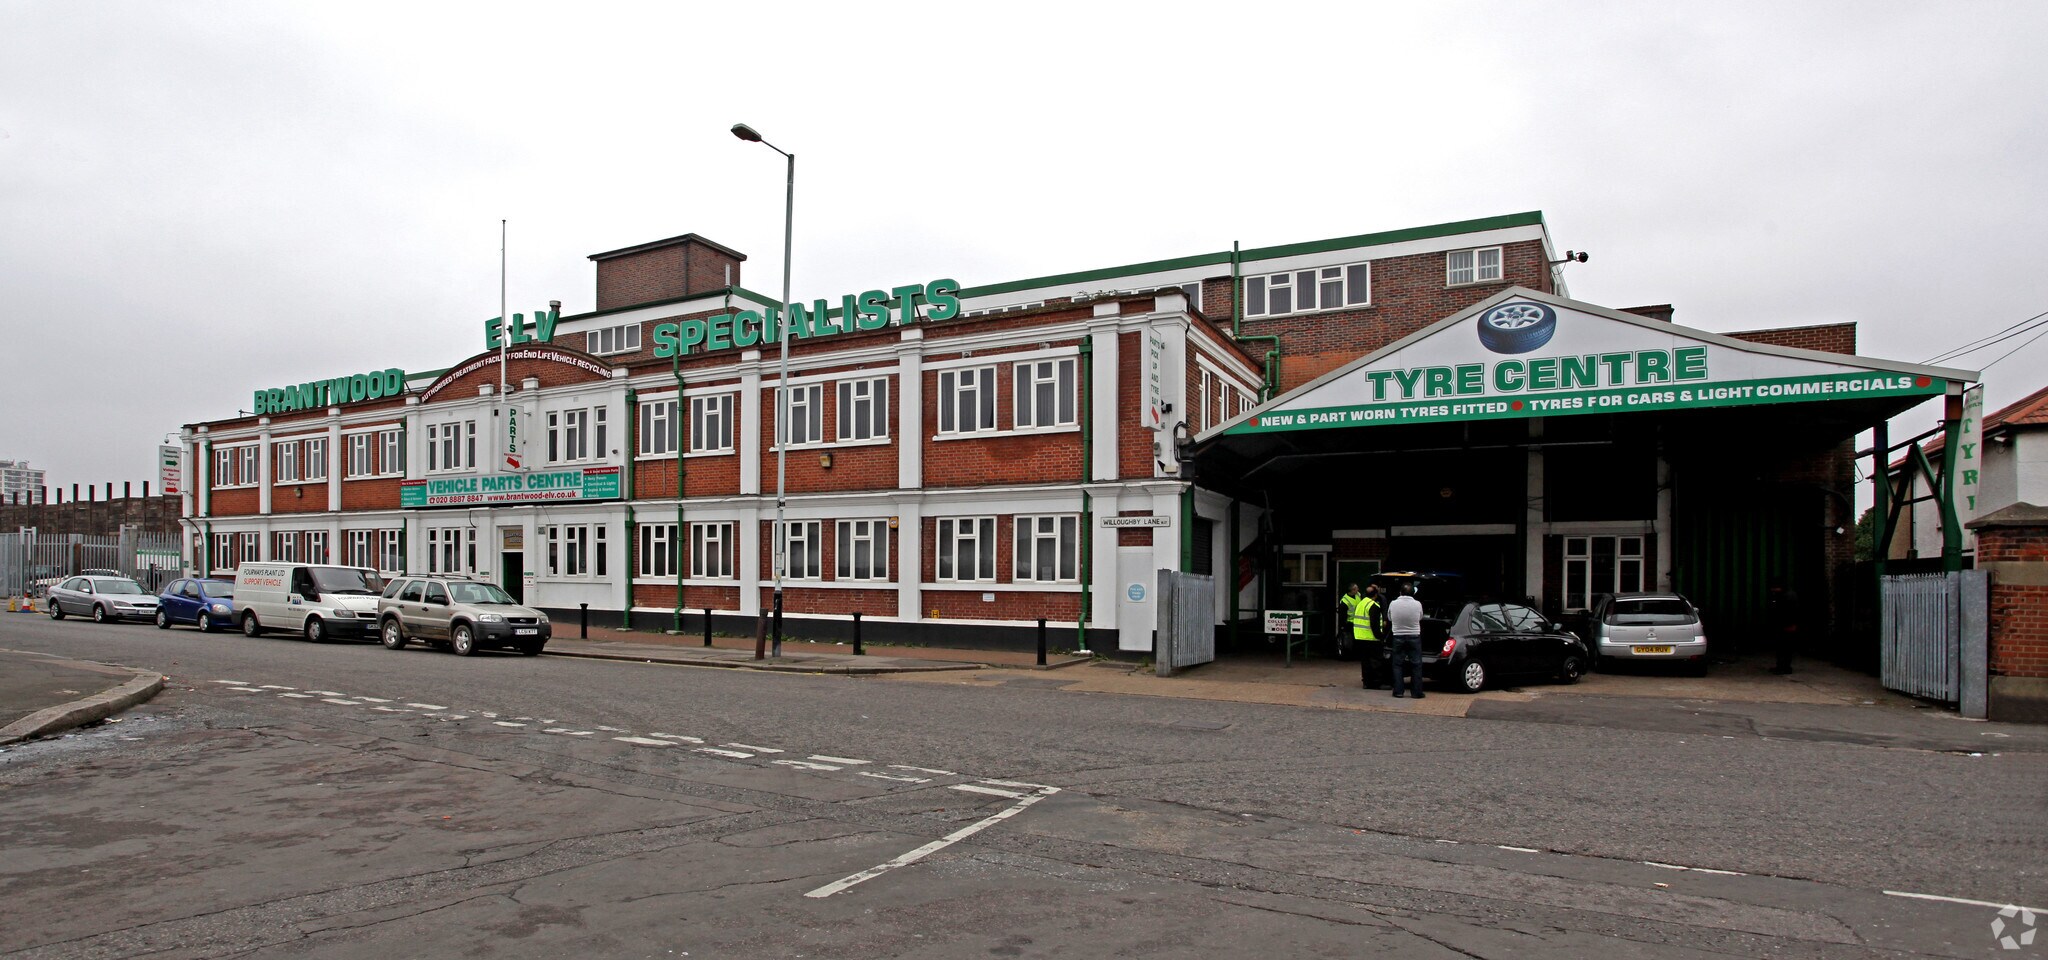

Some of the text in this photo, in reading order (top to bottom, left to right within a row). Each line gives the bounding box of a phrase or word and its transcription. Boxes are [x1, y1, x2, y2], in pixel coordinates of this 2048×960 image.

[485, 311, 559, 350] ELV
[653, 278, 960, 358] SPECIALISTS
[254, 368, 404, 415] BRANTWOOD
[421, 375, 453, 403] AUTHORISED
[452, 360, 485, 379] TREATMENT
[485, 352, 512, 365] FACILY
[577, 360, 612, 378] RECYCLING
[1365, 346, 1708, 401] TYRE CENTRE
[1529, 376, 1912, 411] TYRES FOR CARS & LIGHT COMMERCIALS
[1261, 402, 1508, 427] NEW & PART WORN TYRES FITTED
[428, 472, 582, 494] VEHICLE PARTS CENTRE
[436, 491, 576, 504] 020 8887 8847 www.brantwood-elv.co.uk
